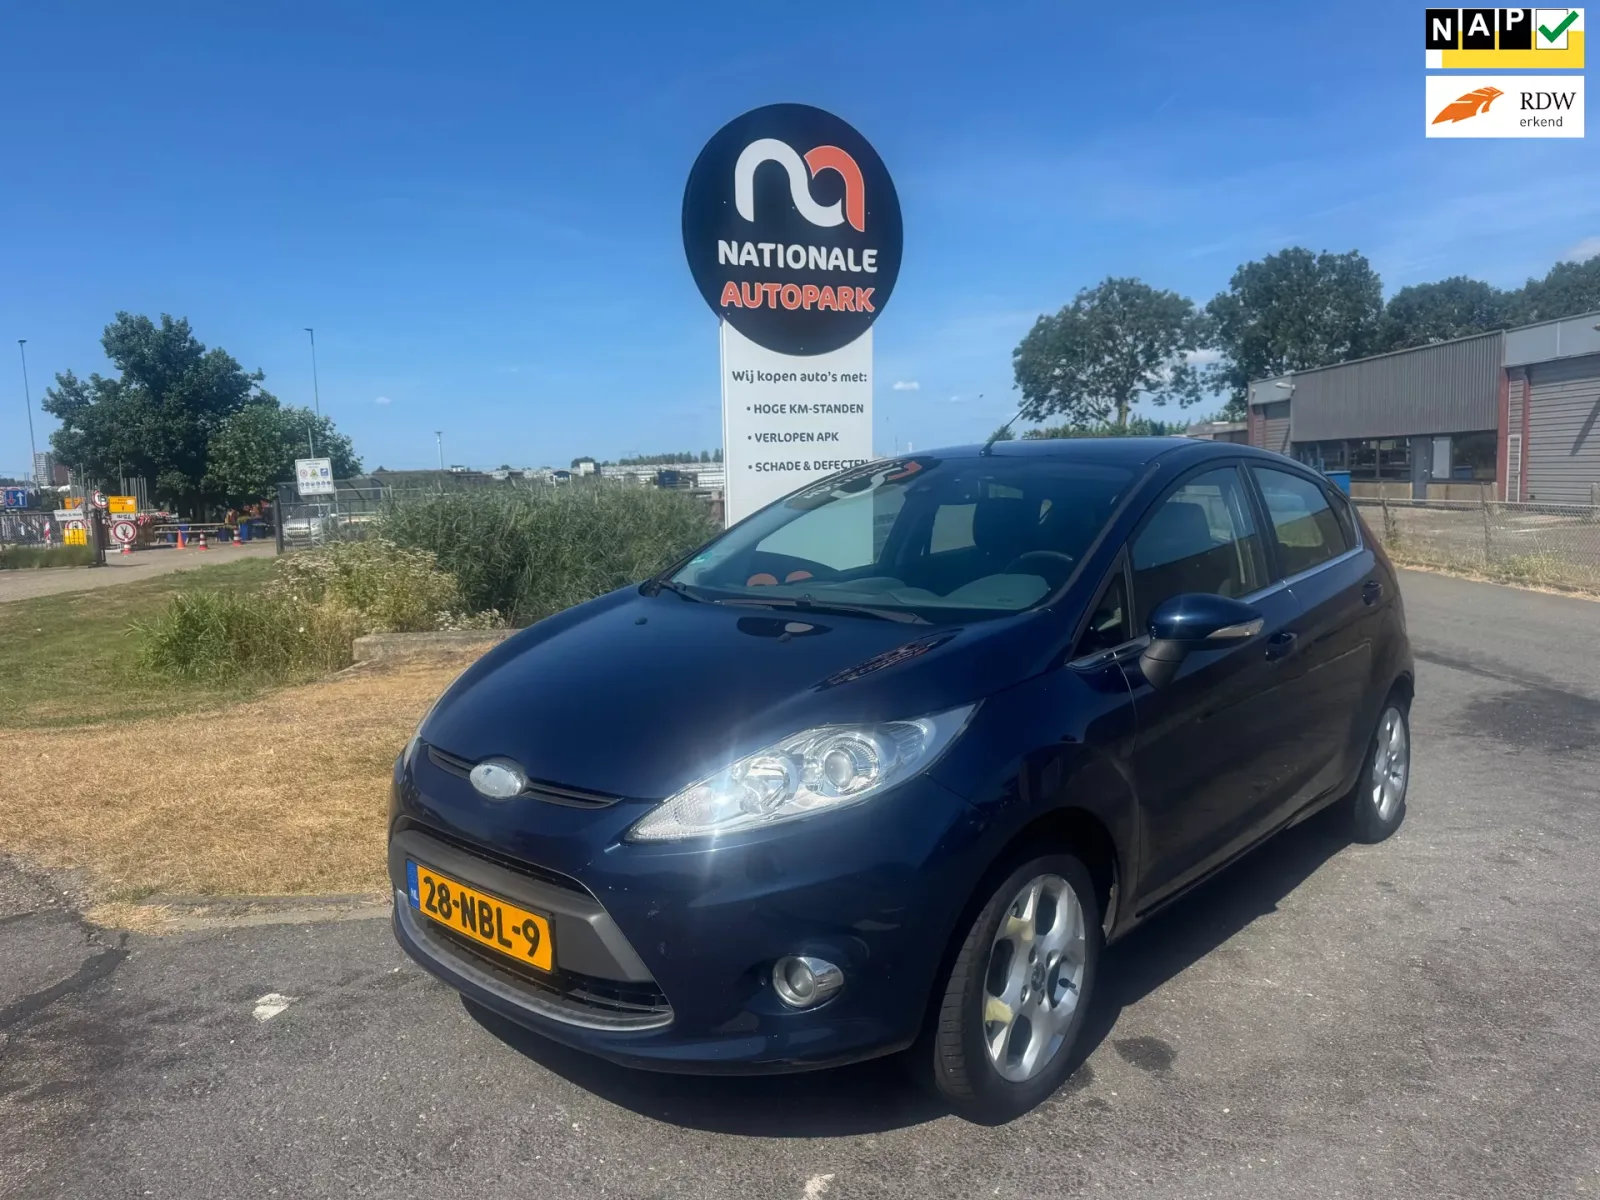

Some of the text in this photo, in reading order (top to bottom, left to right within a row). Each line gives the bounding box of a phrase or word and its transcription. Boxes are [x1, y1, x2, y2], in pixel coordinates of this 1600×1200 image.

[718, 240, 878, 273] NATIONALE
[720, 281, 876, 313] AUTOPARK
[732, 370, 868, 384] Wij kopen auto's met:
[753, 404, 864, 414] HOGE KM-STANDEN
[754, 432, 839, 443] VERLOPEN APK
[755, 461, 801, 472] SCHADE
[803, 461, 811, 471] &
[410, 887, 419, 901] NL
[423, 876, 541, 958] 28-NBL-9
